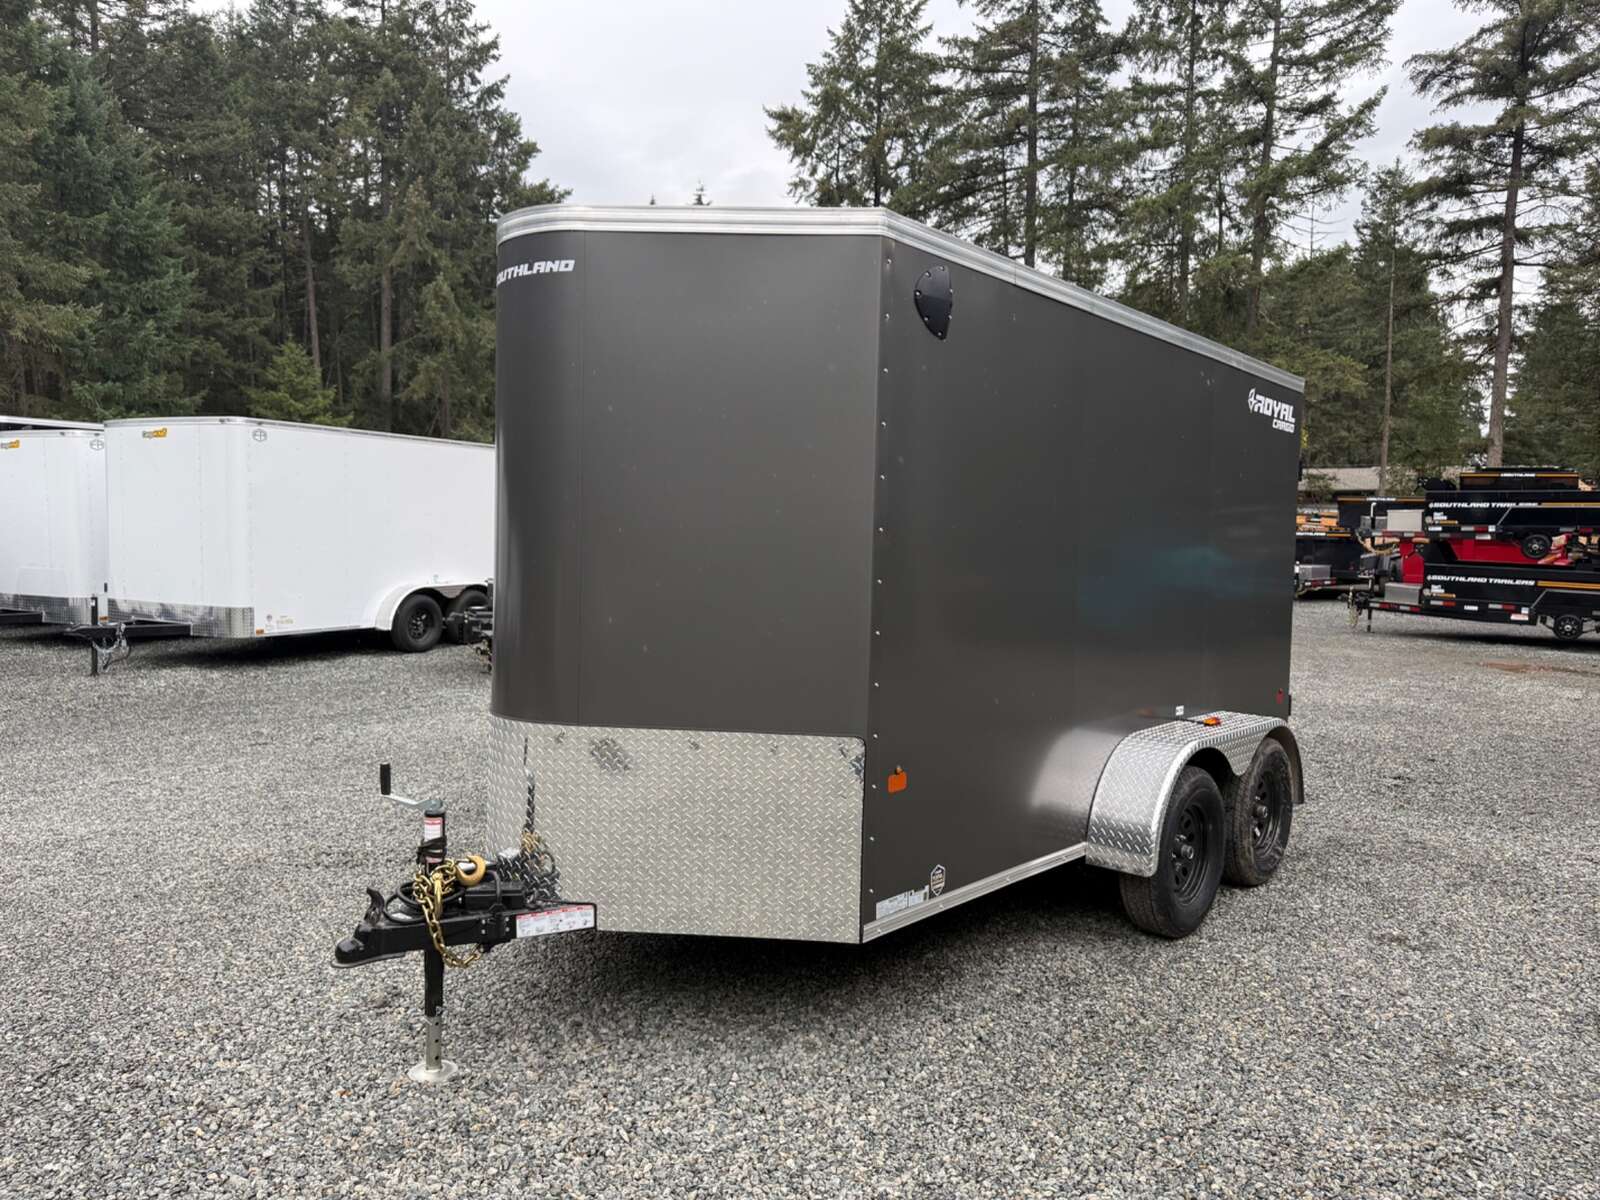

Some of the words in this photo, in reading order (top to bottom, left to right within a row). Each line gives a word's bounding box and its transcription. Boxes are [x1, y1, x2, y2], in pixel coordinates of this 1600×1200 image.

[496, 259, 576, 287] OUTHLAND
[1253, 393, 1295, 423] ROYAL
[1431, 575, 1487, 583] SOUTHLAND
[1488, 577, 1536, 586] TRAILERS
